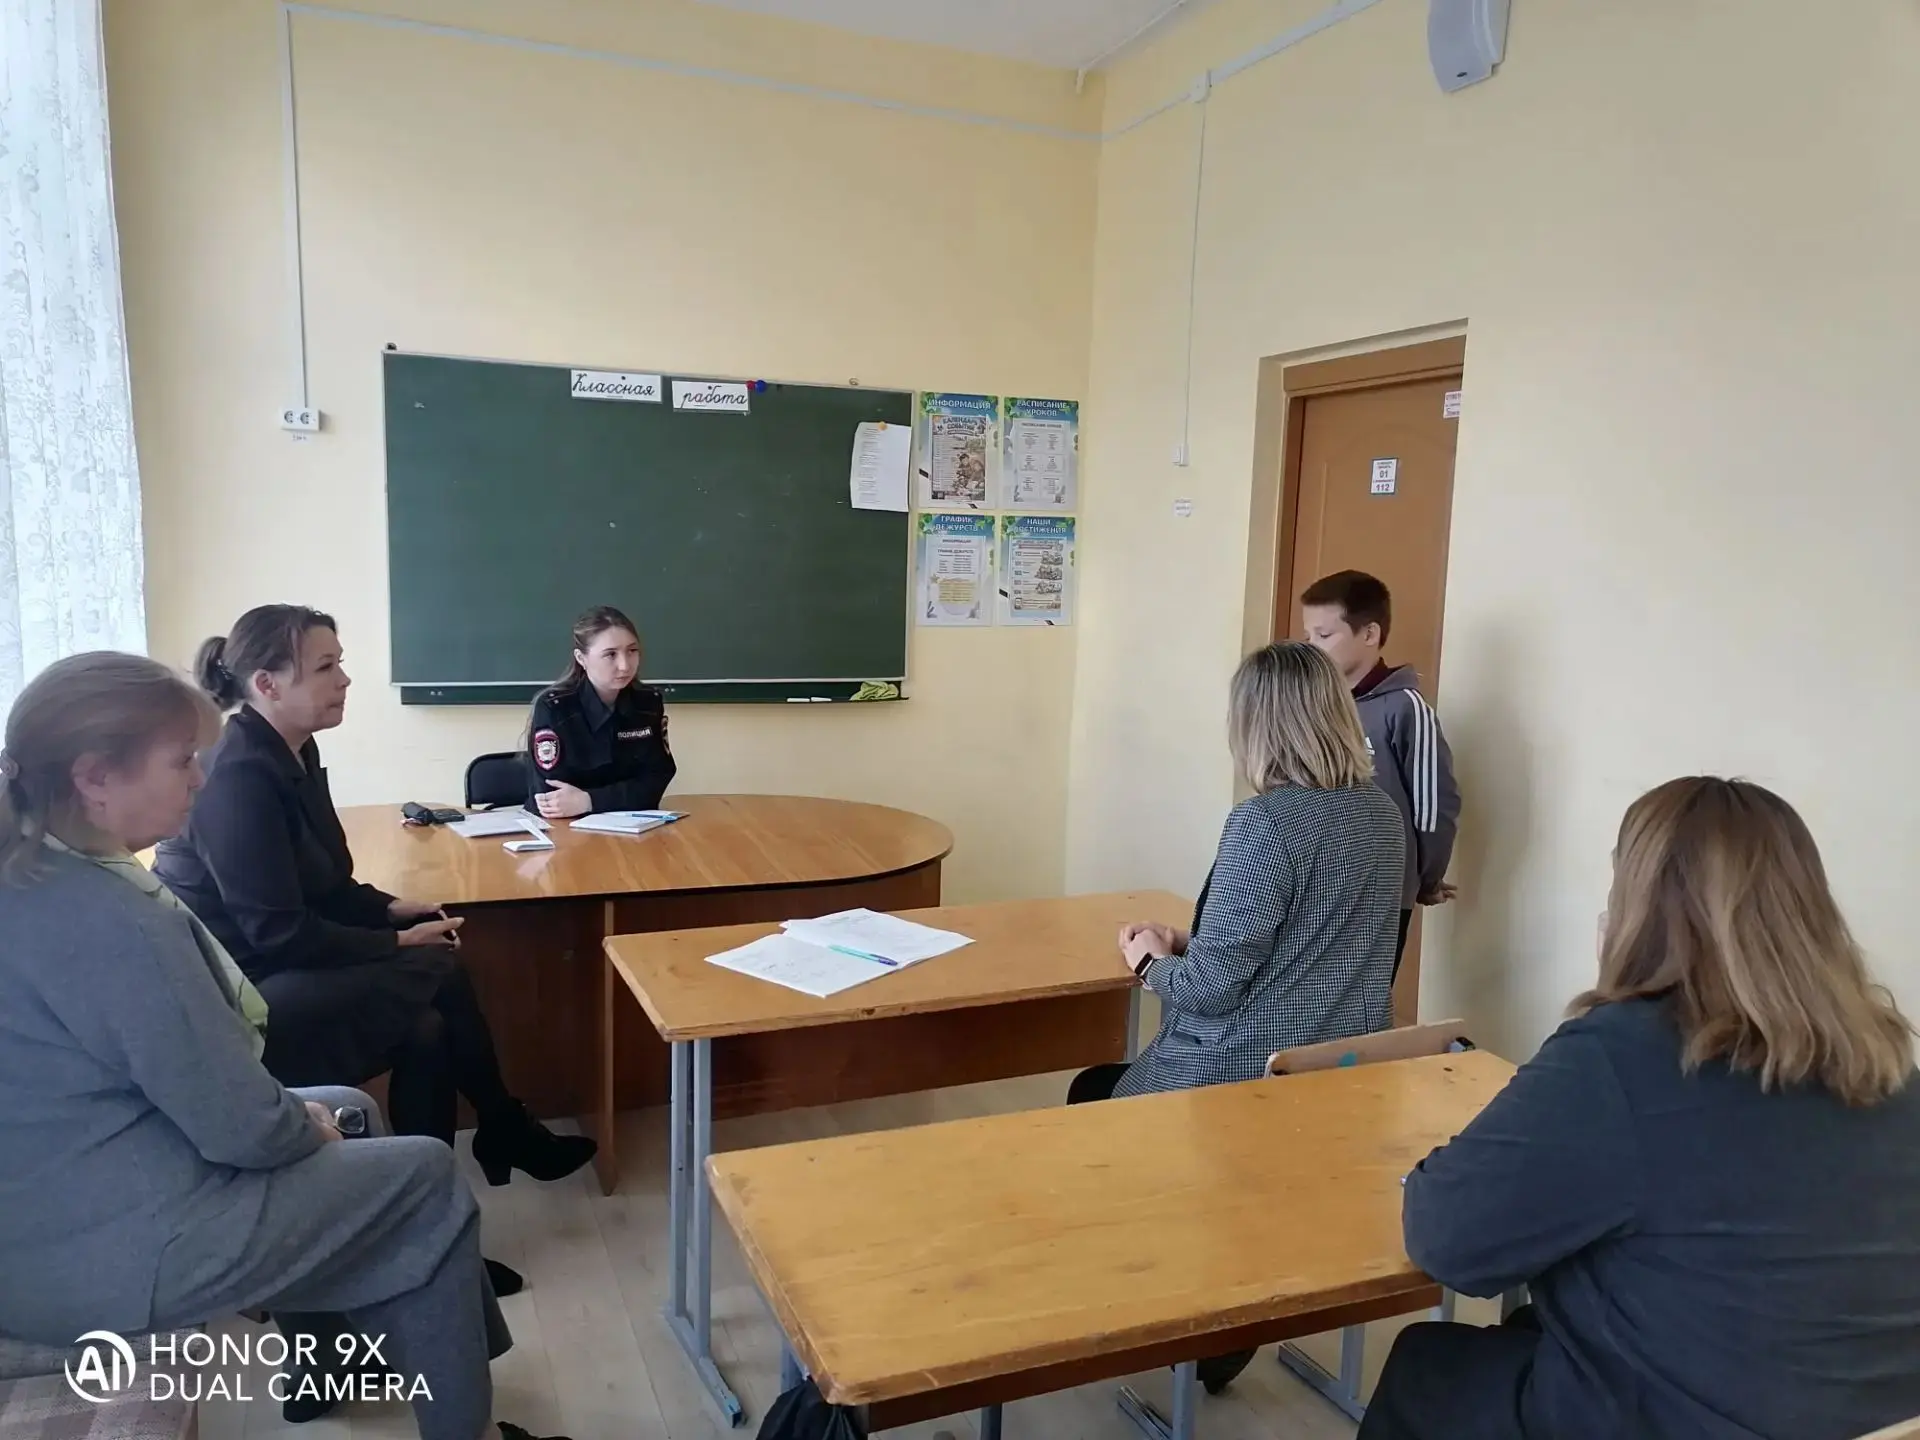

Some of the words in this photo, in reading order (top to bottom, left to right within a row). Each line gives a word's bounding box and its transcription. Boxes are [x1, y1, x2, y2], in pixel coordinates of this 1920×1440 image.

[572, 373, 656, 397] Классная
[681, 385, 749, 409] работа
[927, 398, 992, 410] ИНФОРМАЦИЯ
[1016, 399, 1068, 409] РАСПИСАНИЕ
[1026, 408, 1058, 417] УРОКОВ
[1379, 469, 1389, 479] 01
[1375, 483, 1390, 492] 112
[941, 515, 974, 524] ГРАФИК
[1026, 517, 1051, 526] НАШИ
[617, 728, 651, 739] ПОЛИЦИЯ
